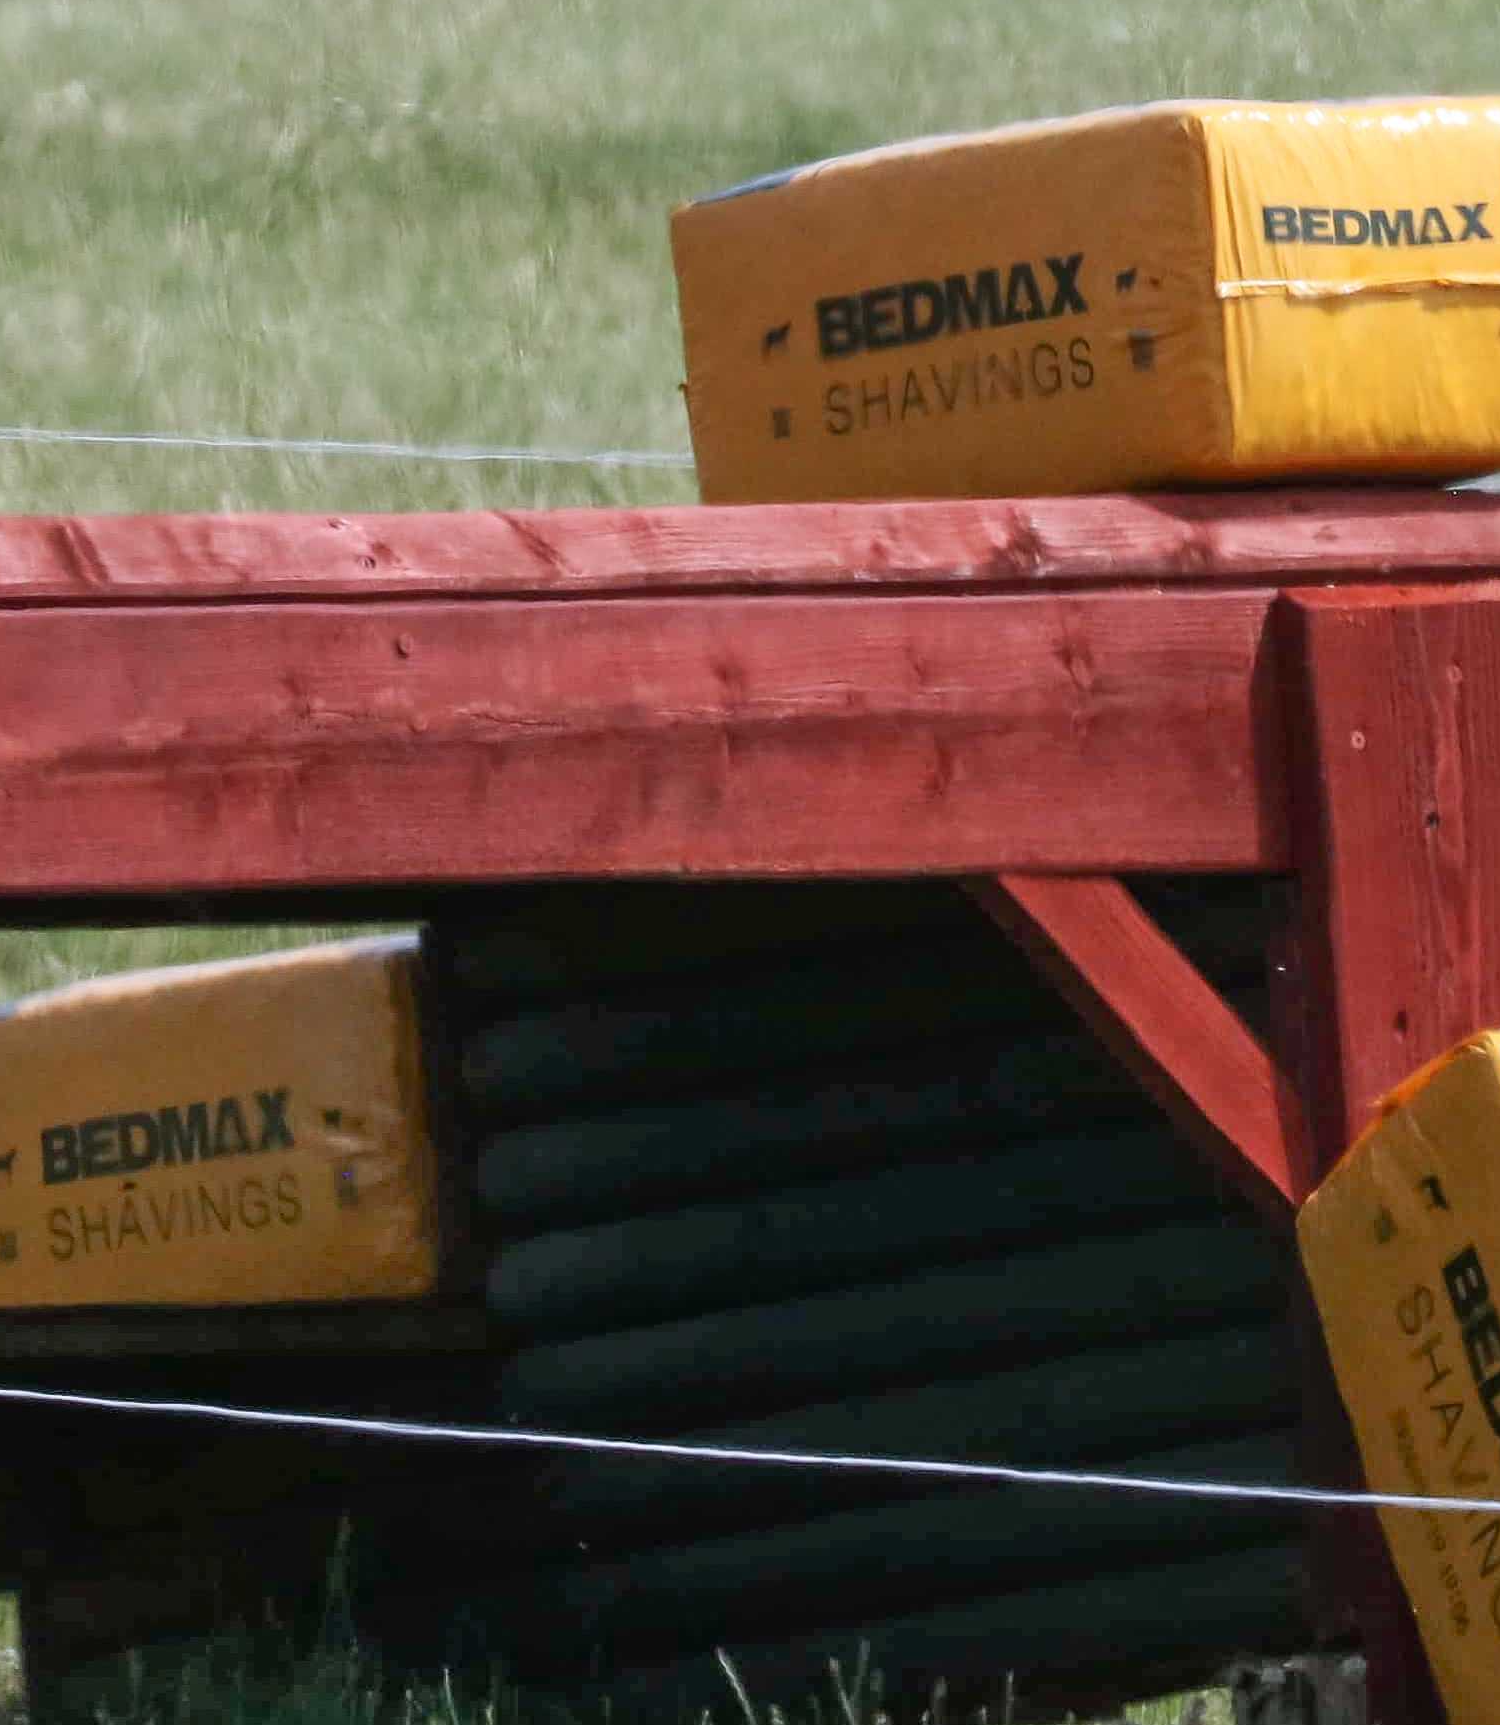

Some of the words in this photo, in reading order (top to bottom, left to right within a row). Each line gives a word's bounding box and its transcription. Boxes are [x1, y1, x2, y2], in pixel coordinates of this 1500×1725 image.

[1262, 202, 1493, 247] BEDMAX
[816, 253, 1088, 361] BEDMAX
[826, 335, 1095, 437] SHAVINGS
[40, 1086, 295, 1185] BEDMAX
[48, 1175, 303, 1261] SHAVINGS
